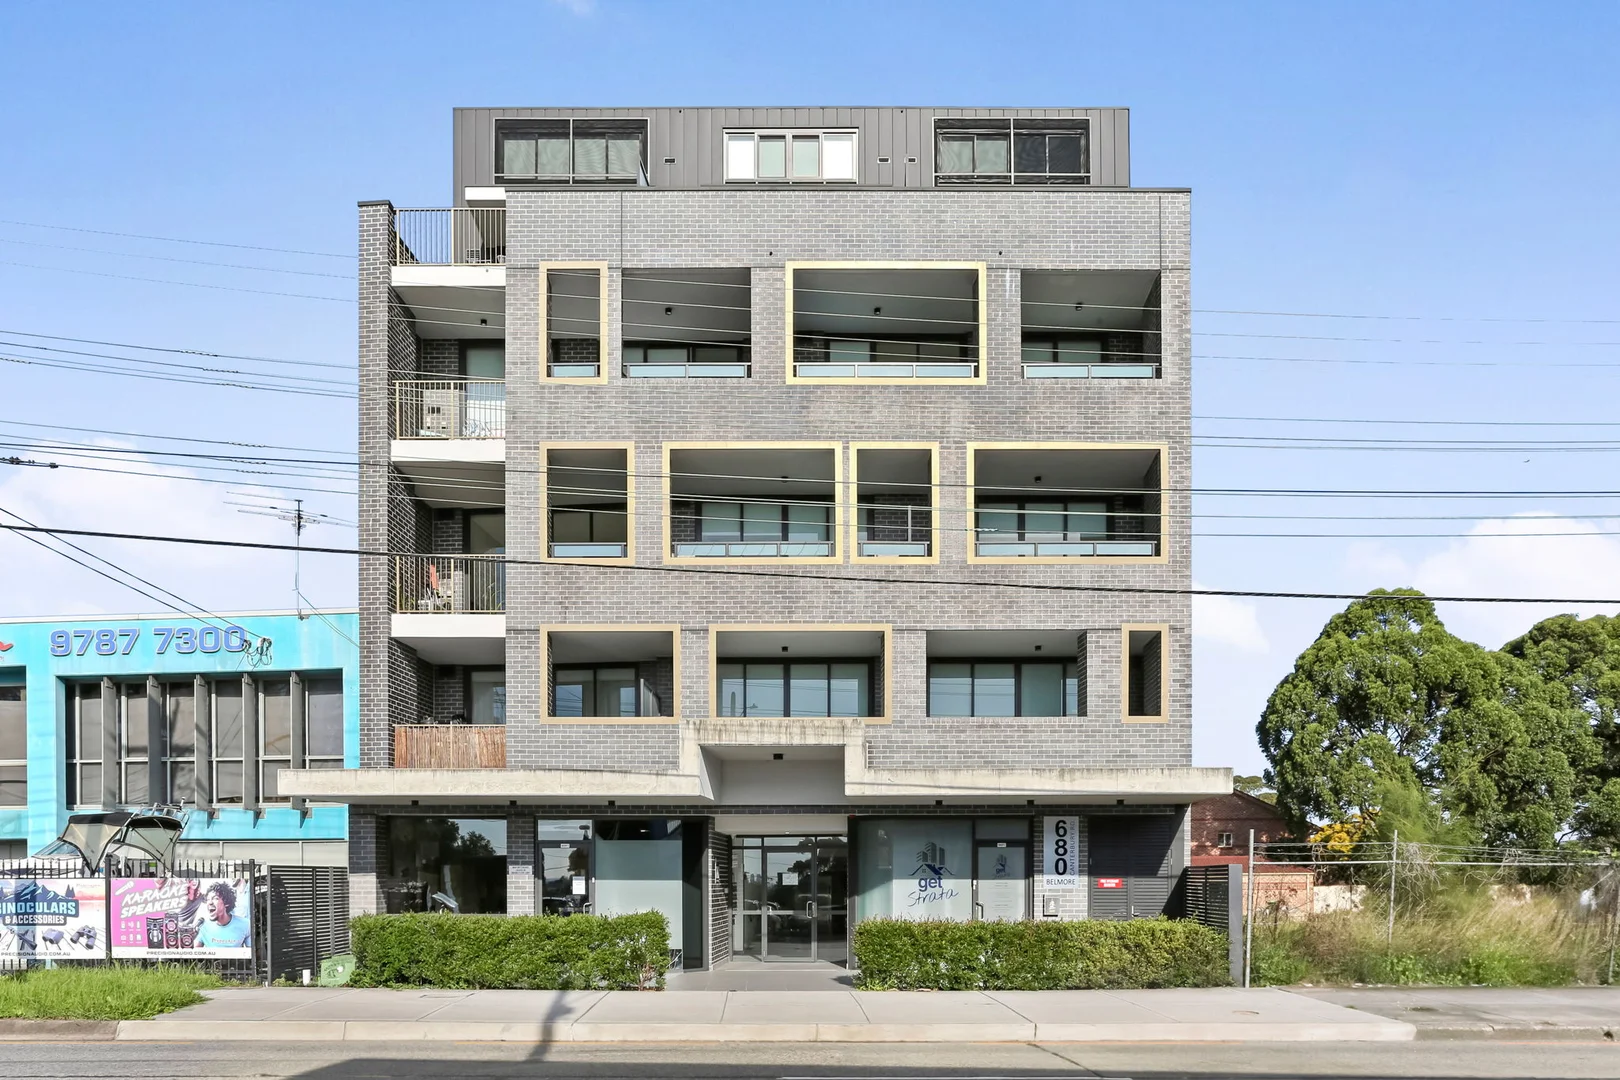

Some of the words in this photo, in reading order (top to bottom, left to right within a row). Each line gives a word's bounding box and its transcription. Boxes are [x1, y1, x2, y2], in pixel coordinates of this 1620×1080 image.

[50, 628, 140, 656] 9787
[153, 626, 246, 654] 7300
[1054, 819, 1068, 876] 680
[918, 876, 943, 892] get
[1046, 878, 1076, 886] BELMORE
[121, 883, 189, 907] KARAOKE
[907, 887, 959, 907] Strata
[0, 901, 76, 915] INOCULARS
[120, 896, 187, 919] SPEAKERS
[4, 915, 12, 924] &
[12, 914, 65, 924] ACCESSORIES
